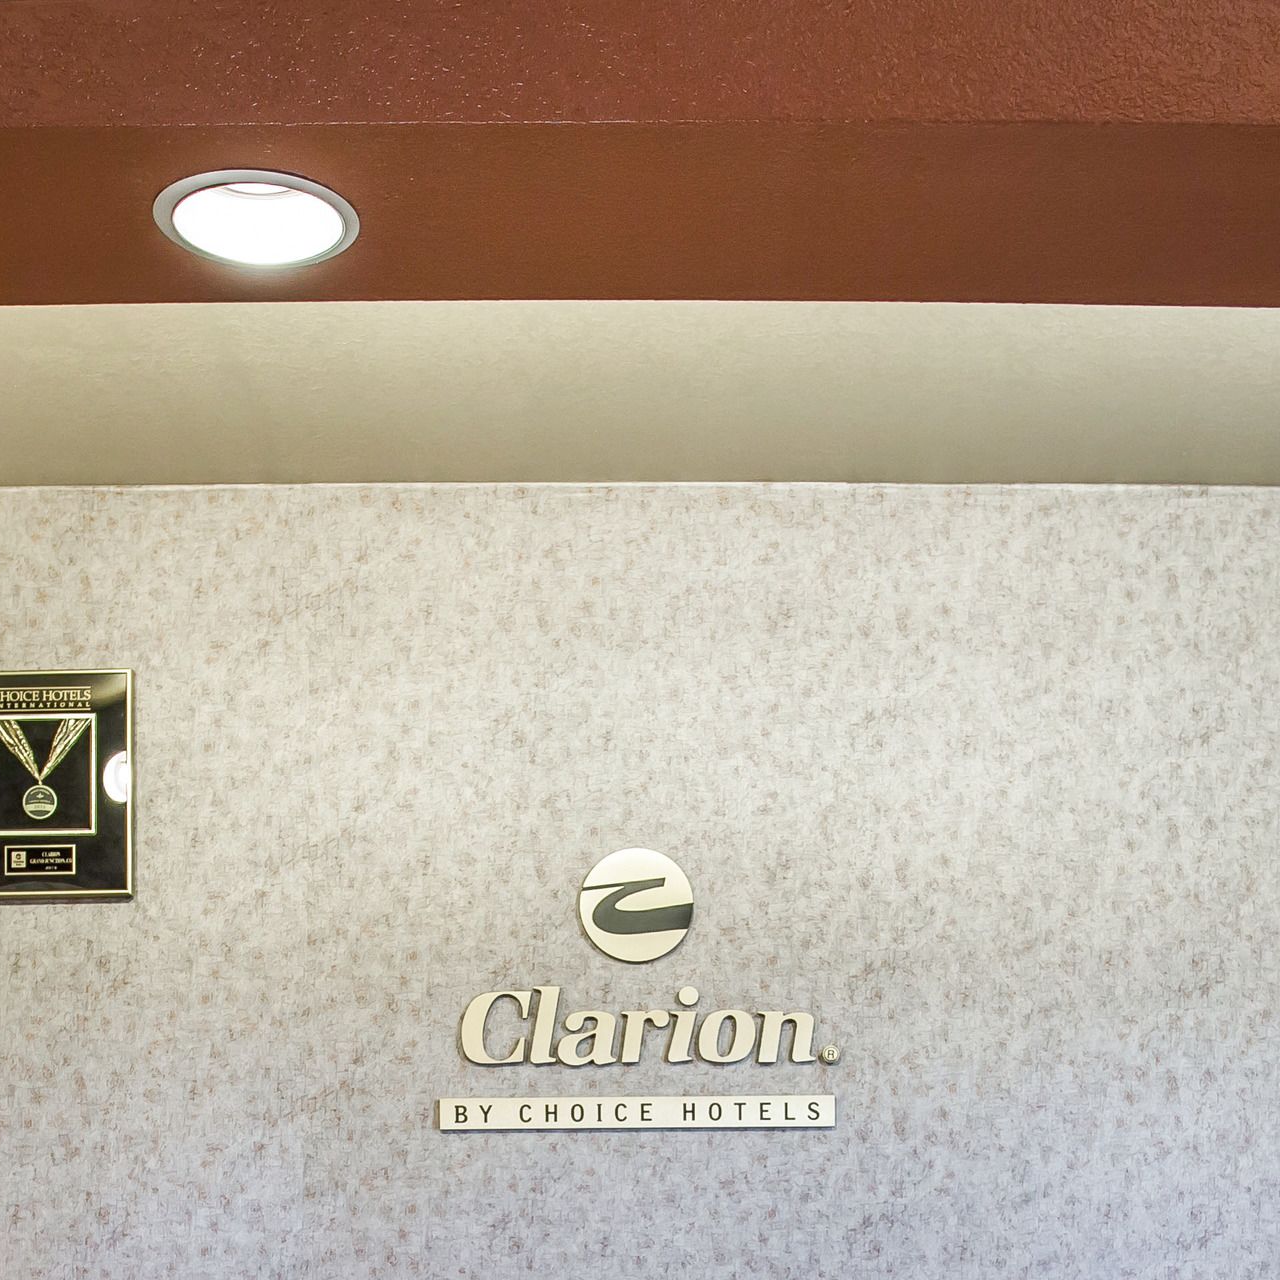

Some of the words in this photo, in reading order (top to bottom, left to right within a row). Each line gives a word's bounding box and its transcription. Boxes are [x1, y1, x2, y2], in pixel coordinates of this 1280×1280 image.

[42, 690, 91, 702] HOTELS
[460, 985, 818, 1067] Clarion
[453, 1104, 494, 1125] BY
[518, 1102, 655, 1124] CHOICE
[683, 1101, 822, 1123] HOTELS
